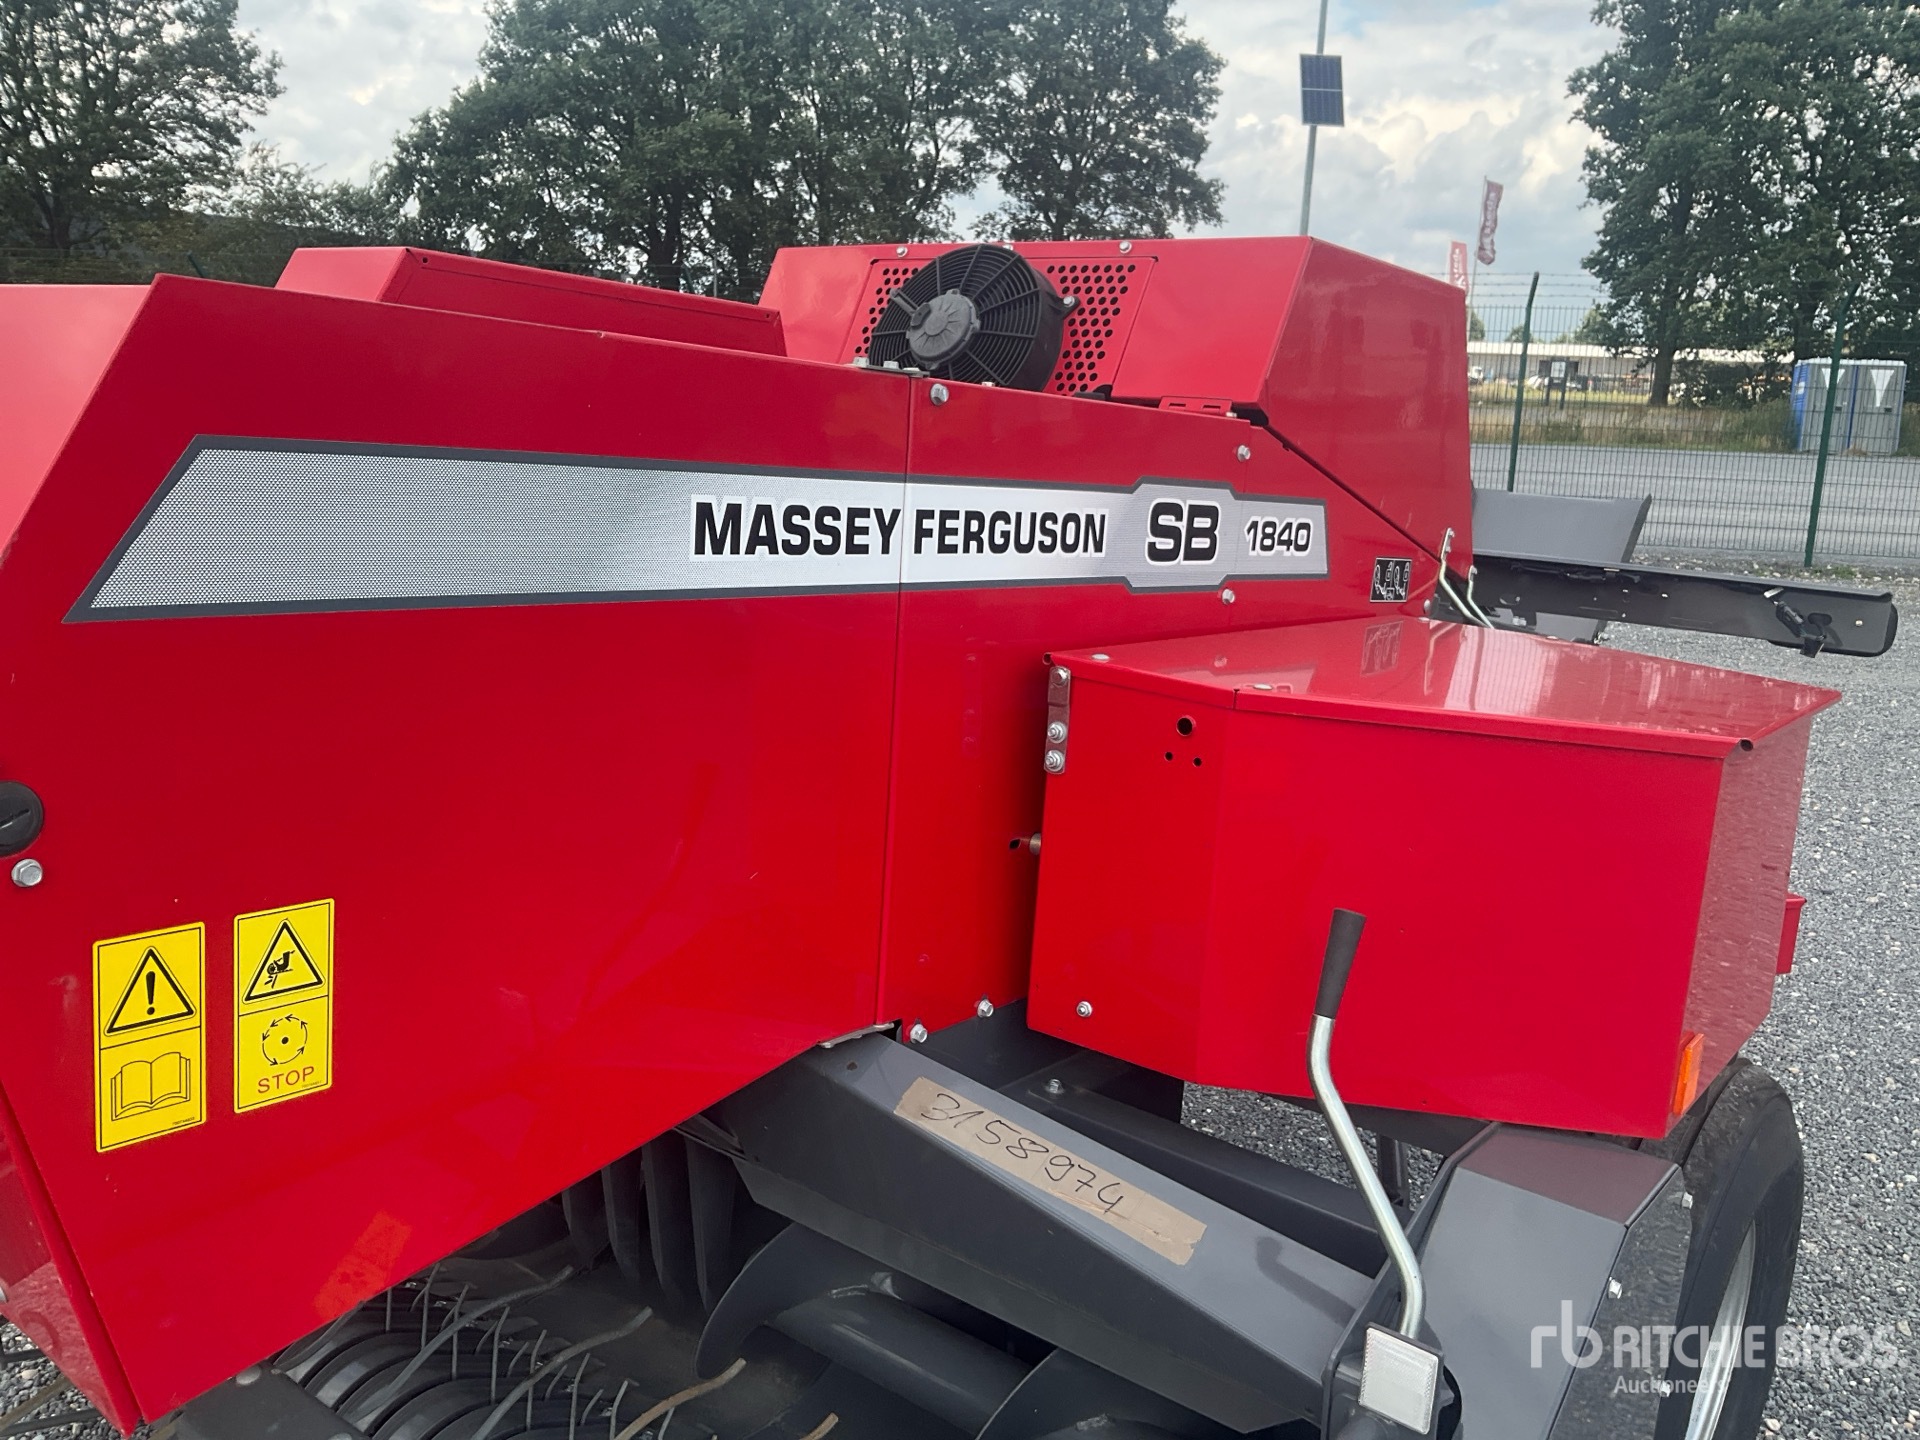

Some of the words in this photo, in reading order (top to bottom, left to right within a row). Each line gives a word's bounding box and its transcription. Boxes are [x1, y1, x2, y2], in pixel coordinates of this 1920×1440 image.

[694, 500, 901, 556] MASSEY
[912, 508, 1106, 555] FERGUSON
[1146, 501, 1220, 562] SB
[1247, 519, 1312, 552] 1840
[257, 1066, 314, 1093] STOP
